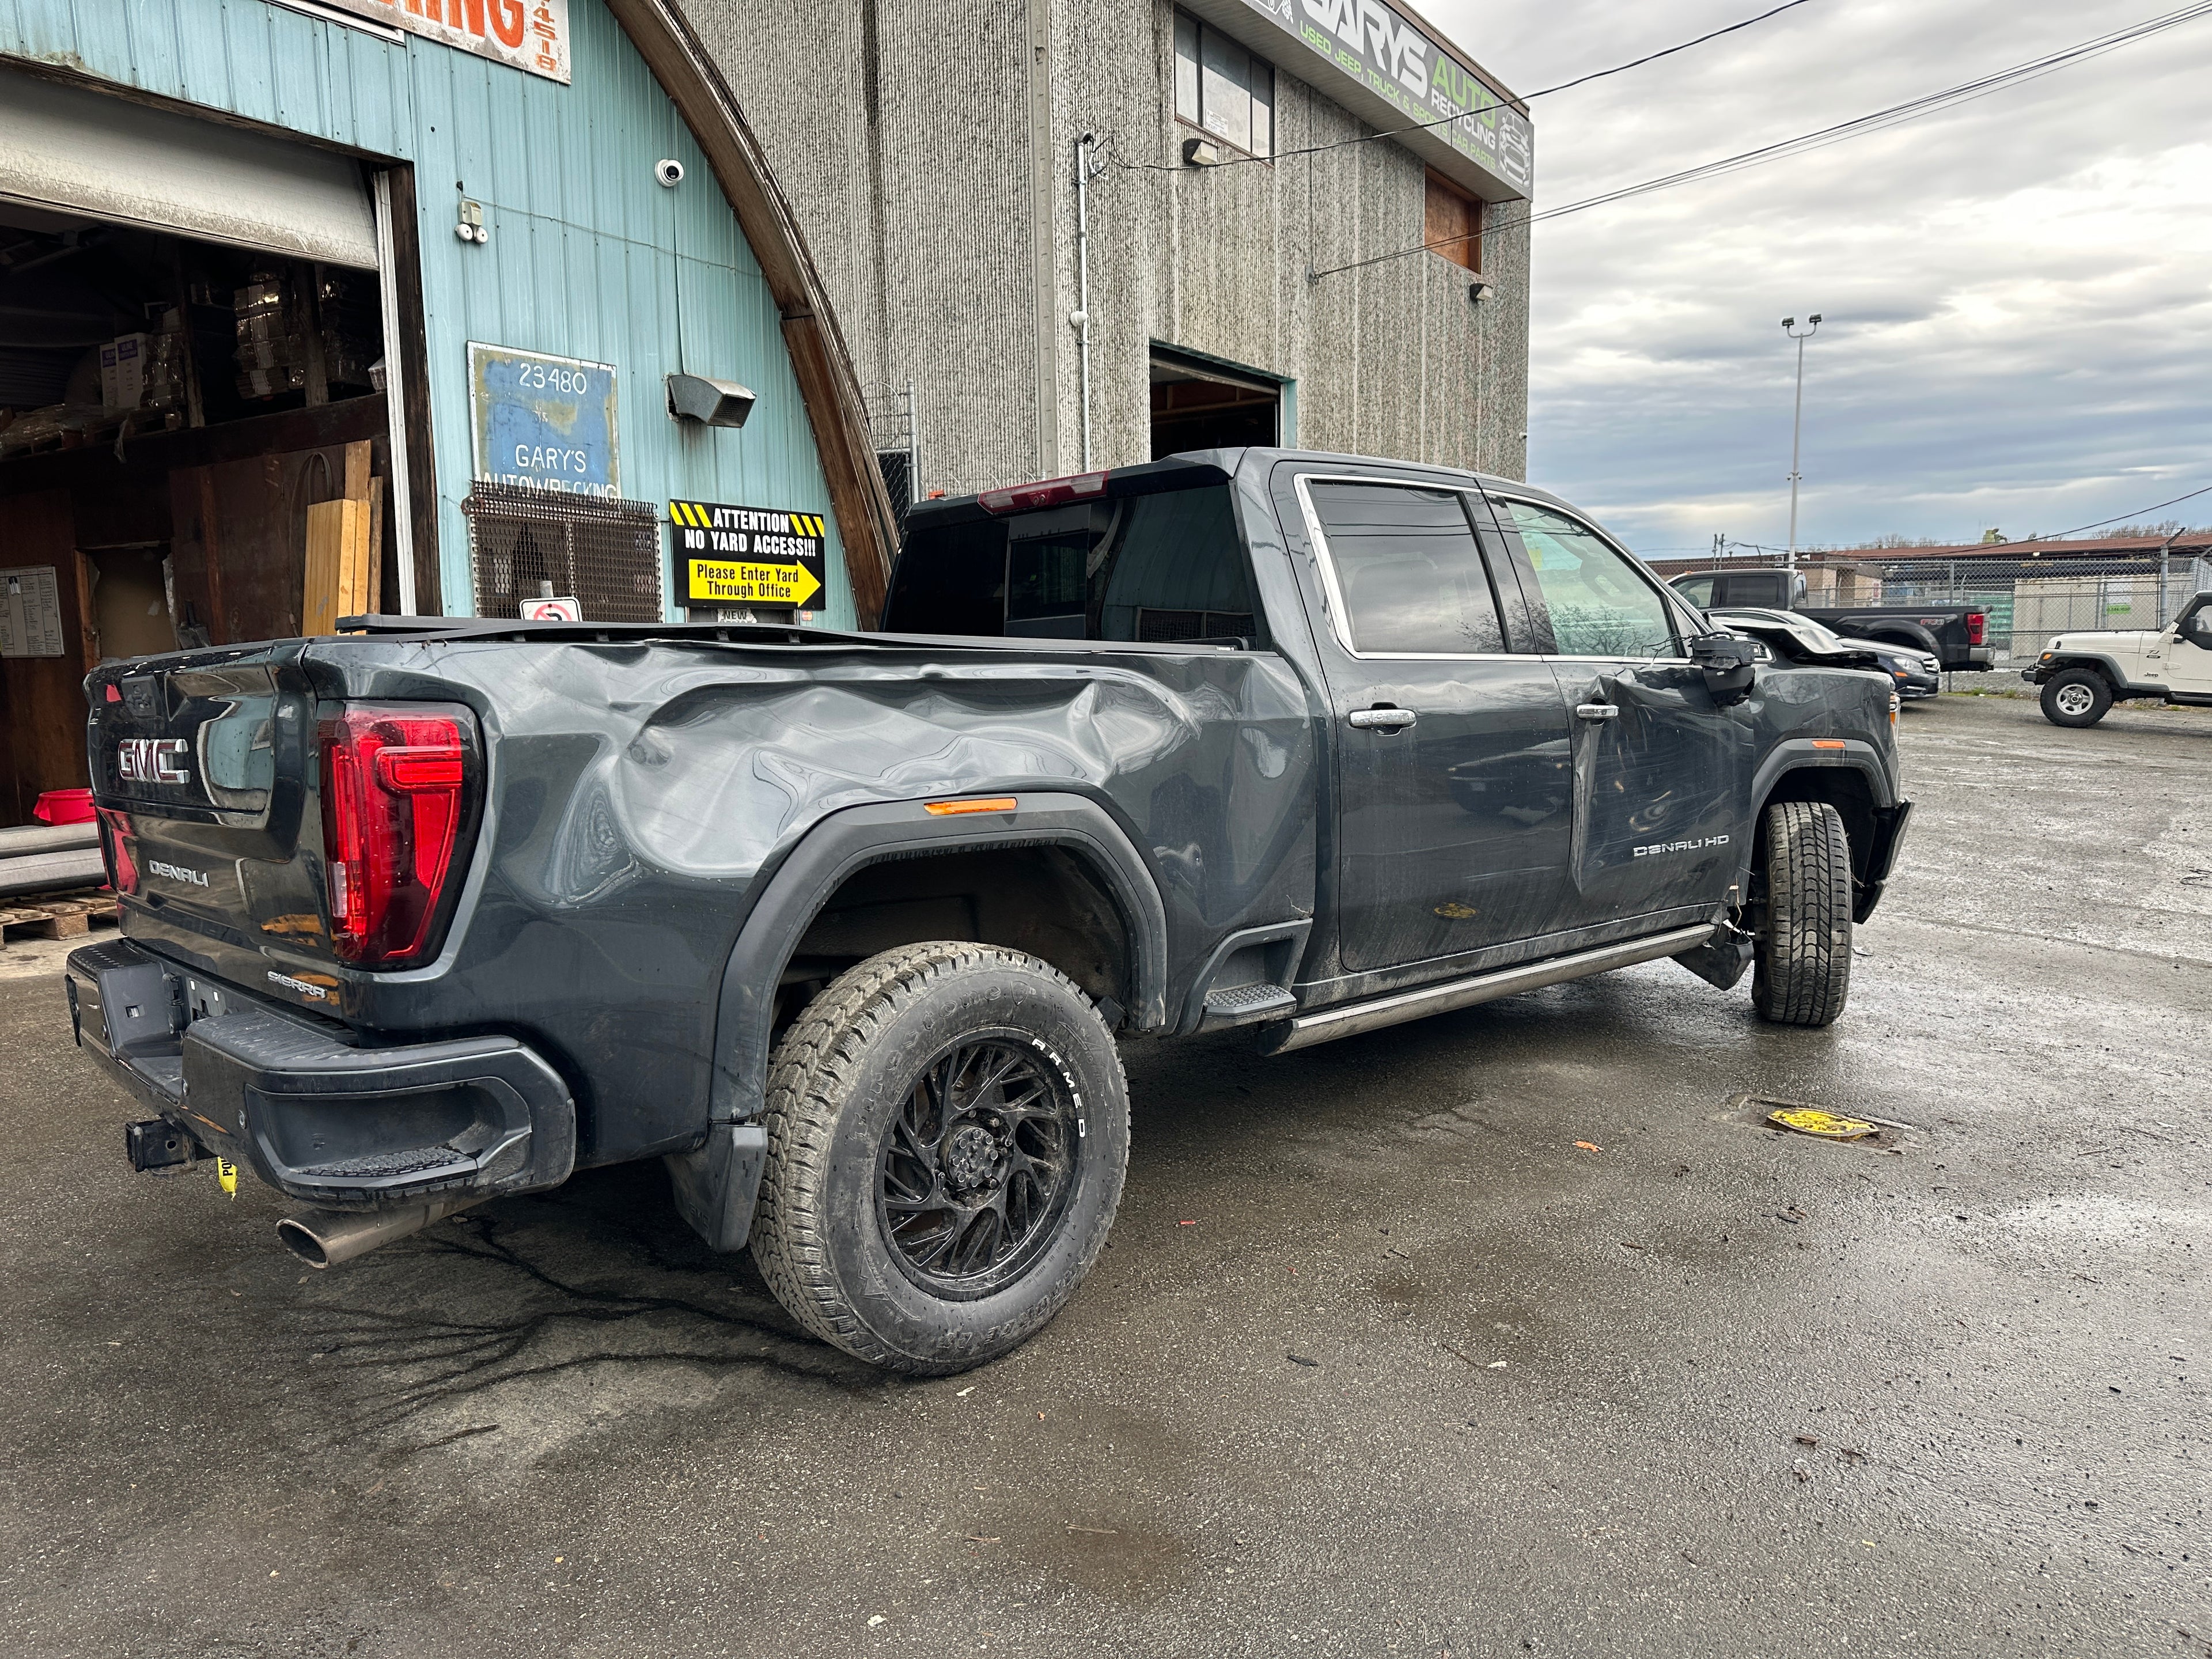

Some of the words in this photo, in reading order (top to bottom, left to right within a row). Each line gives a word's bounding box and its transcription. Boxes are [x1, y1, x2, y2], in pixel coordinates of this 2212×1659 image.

[1300, 20, 1332, 55] USED
[1334, 48, 1364, 82] JEEP,
[1367, 68, 1400, 104] TRUCK
[1403, 94, 1410, 111] &
[1412, 102, 1448, 138] SPORTS
[1452, 128, 1468, 151] CAR
[1471, 142, 1496, 170] PARTS
[1431, 55, 1496, 130] AUTO
[1431, 87, 1496, 150] RECYCLING
[519, 362, 587, 395] 23480
[515, 444, 586, 473] GARY'S
[713, 507, 789, 533] ATTENTION
[685, 529, 705, 550] NO
[710, 531, 748, 552] YARD
[753, 535, 816, 556] ACCESS!!!
[697, 563, 735, 579] Please
[741, 566, 771, 581] Enter
[775, 568, 798, 583] Yard
[707, 581, 753, 599] Through
[759, 583, 791, 597] Office
[723, 609, 747, 620] NEW
[118, 738, 191, 785] GMC
[1633, 839, 1702, 857] DENALI
[1705, 835, 1729, 847] HD
[149, 859, 210, 888] DENALI
[267, 971, 326, 999] SIERRA
[1031, 1037, 1086, 1138] ARMED
